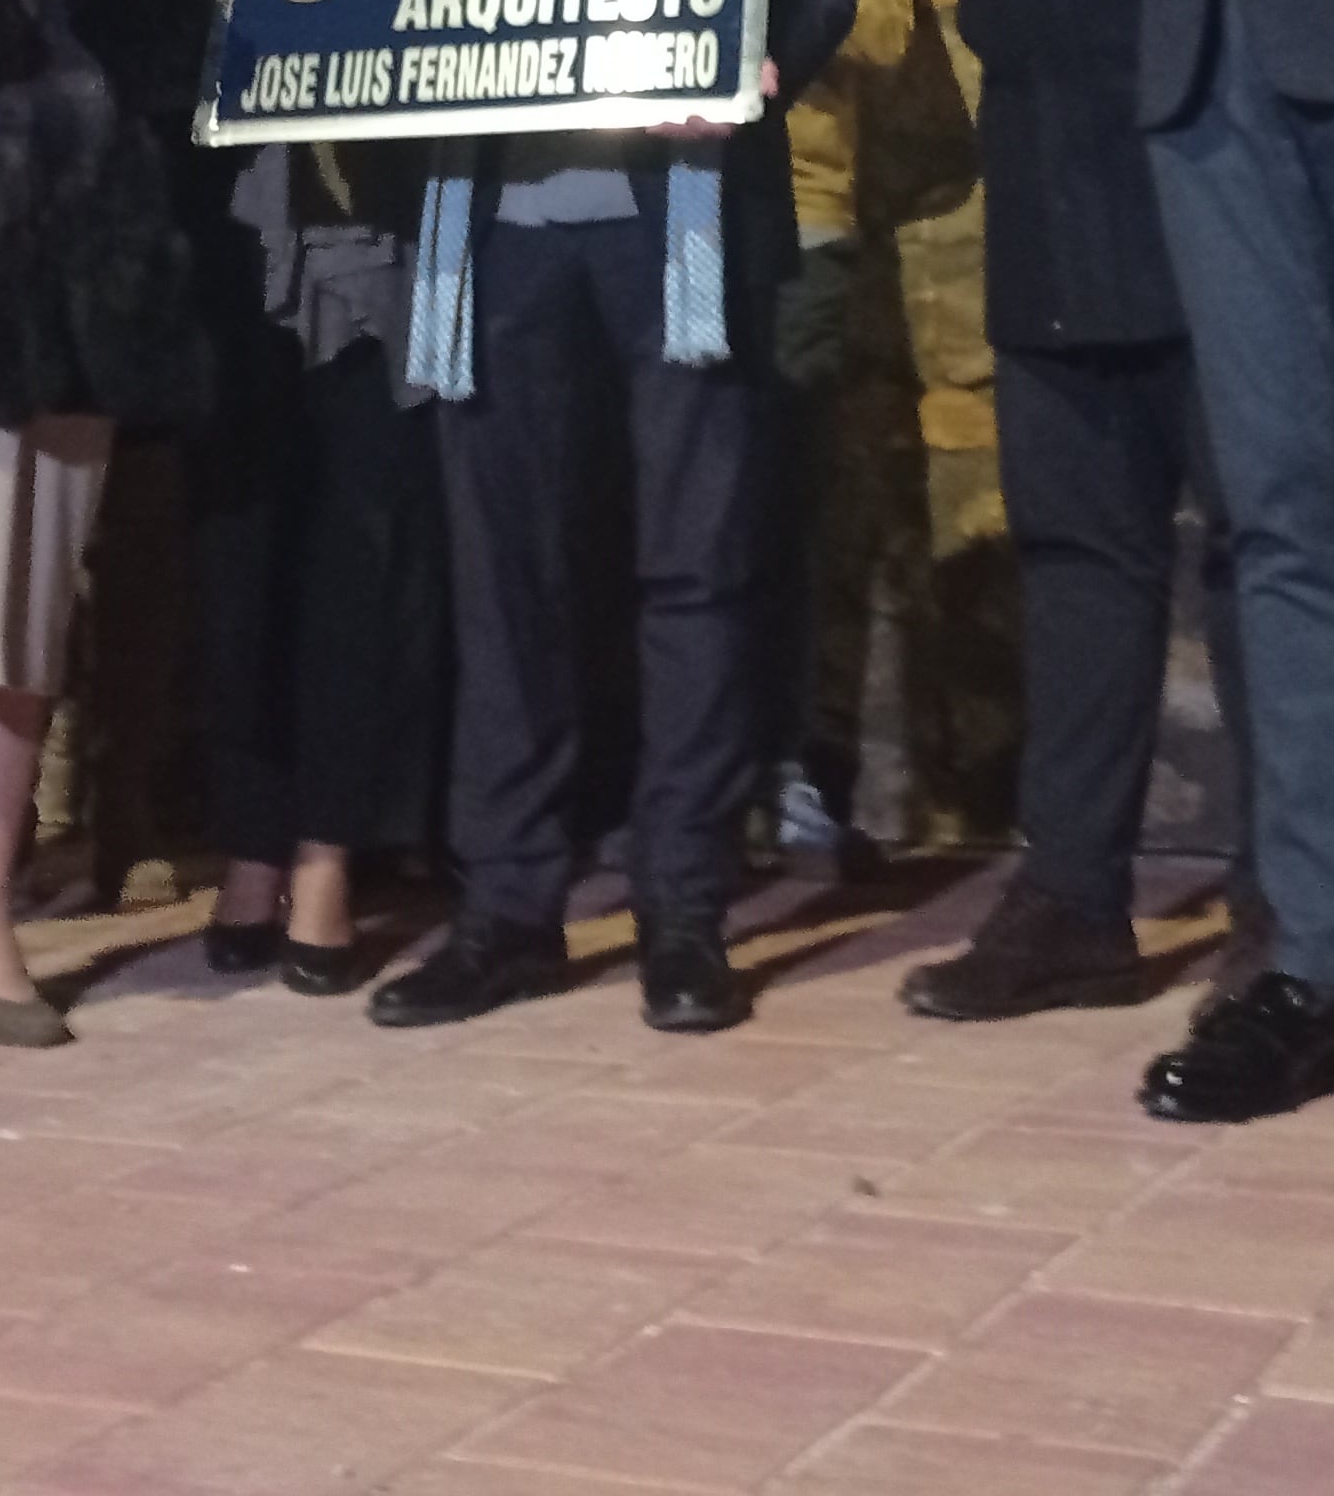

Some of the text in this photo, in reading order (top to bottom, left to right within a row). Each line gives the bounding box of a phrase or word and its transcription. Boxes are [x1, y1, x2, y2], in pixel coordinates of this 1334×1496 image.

[241, 29, 719, 113] JOSE LUIS FERNANDEZ ROERO
